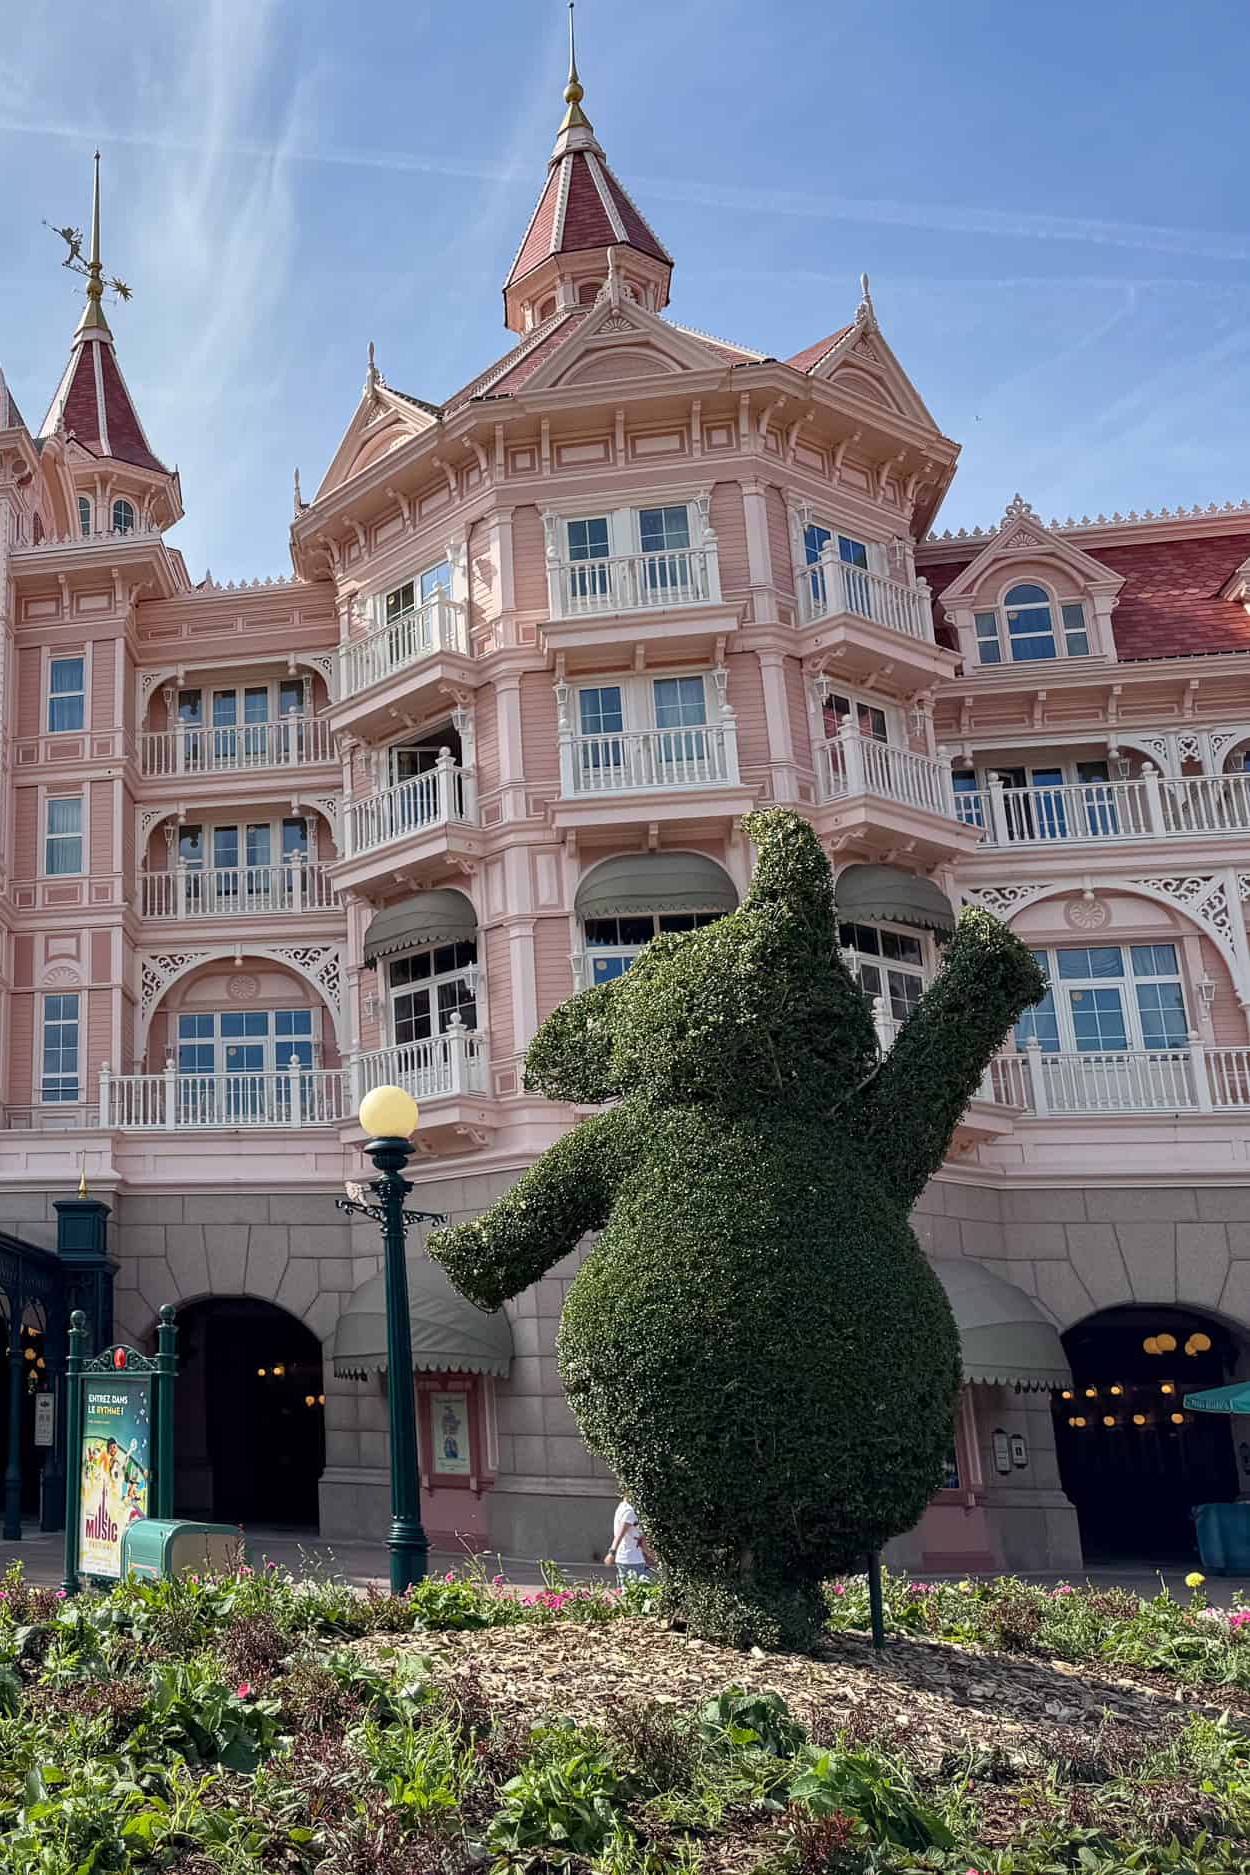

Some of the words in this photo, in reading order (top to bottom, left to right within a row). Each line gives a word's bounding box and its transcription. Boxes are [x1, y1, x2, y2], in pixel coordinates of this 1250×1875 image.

[88, 1394, 110, 1404] ENTREZ
[111, 1395, 128, 1405] DANS
[87, 1405, 95, 1414] LE
[85, 1503, 118, 1543] MUSIC
